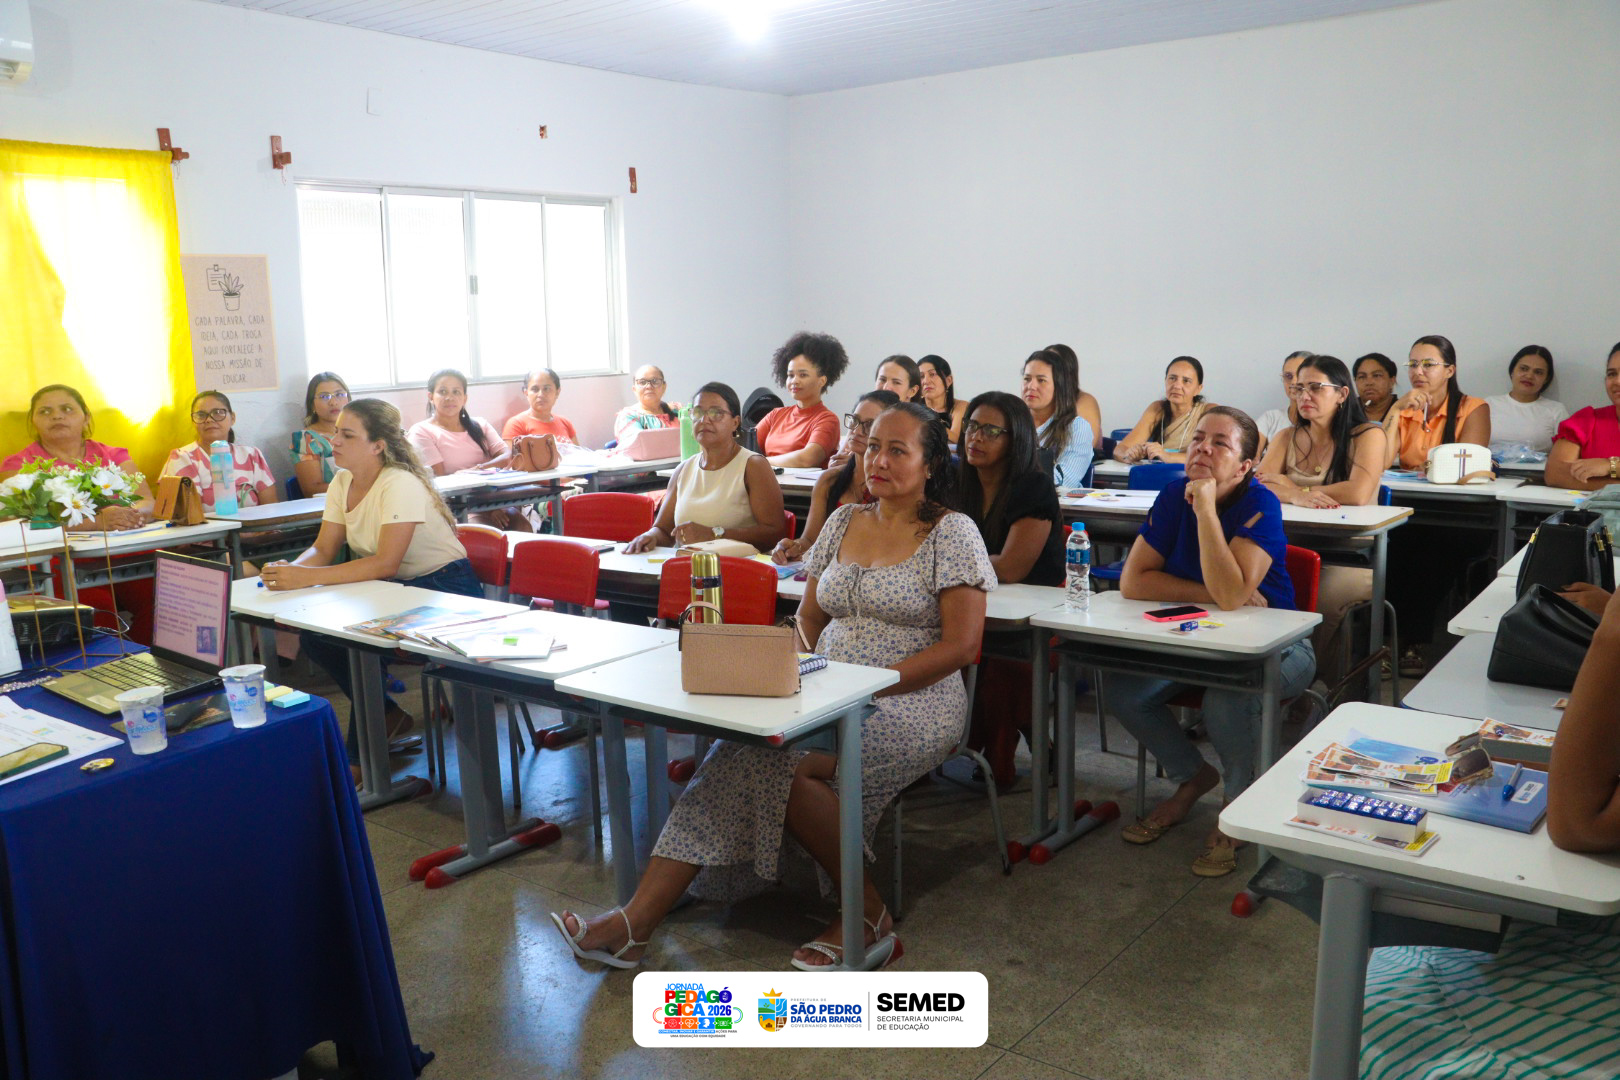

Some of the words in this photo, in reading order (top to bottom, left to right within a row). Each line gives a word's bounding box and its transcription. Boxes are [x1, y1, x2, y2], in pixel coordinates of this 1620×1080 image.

[195, 316, 212, 326] CADA
[214, 315, 246, 326] PALAVRA,
[248, 314, 265, 325] CADA
[221, 330, 239, 340] CADA
[242, 329, 262, 339] TROCA
[203, 346, 219, 356] AQUI
[221, 344, 254, 355] FORTALECE
[258, 343, 263, 353] A
[205, 360, 226, 370] NOSSA
[229, 358, 252, 369] MISSÃO
[255, 358, 263, 368] DE
